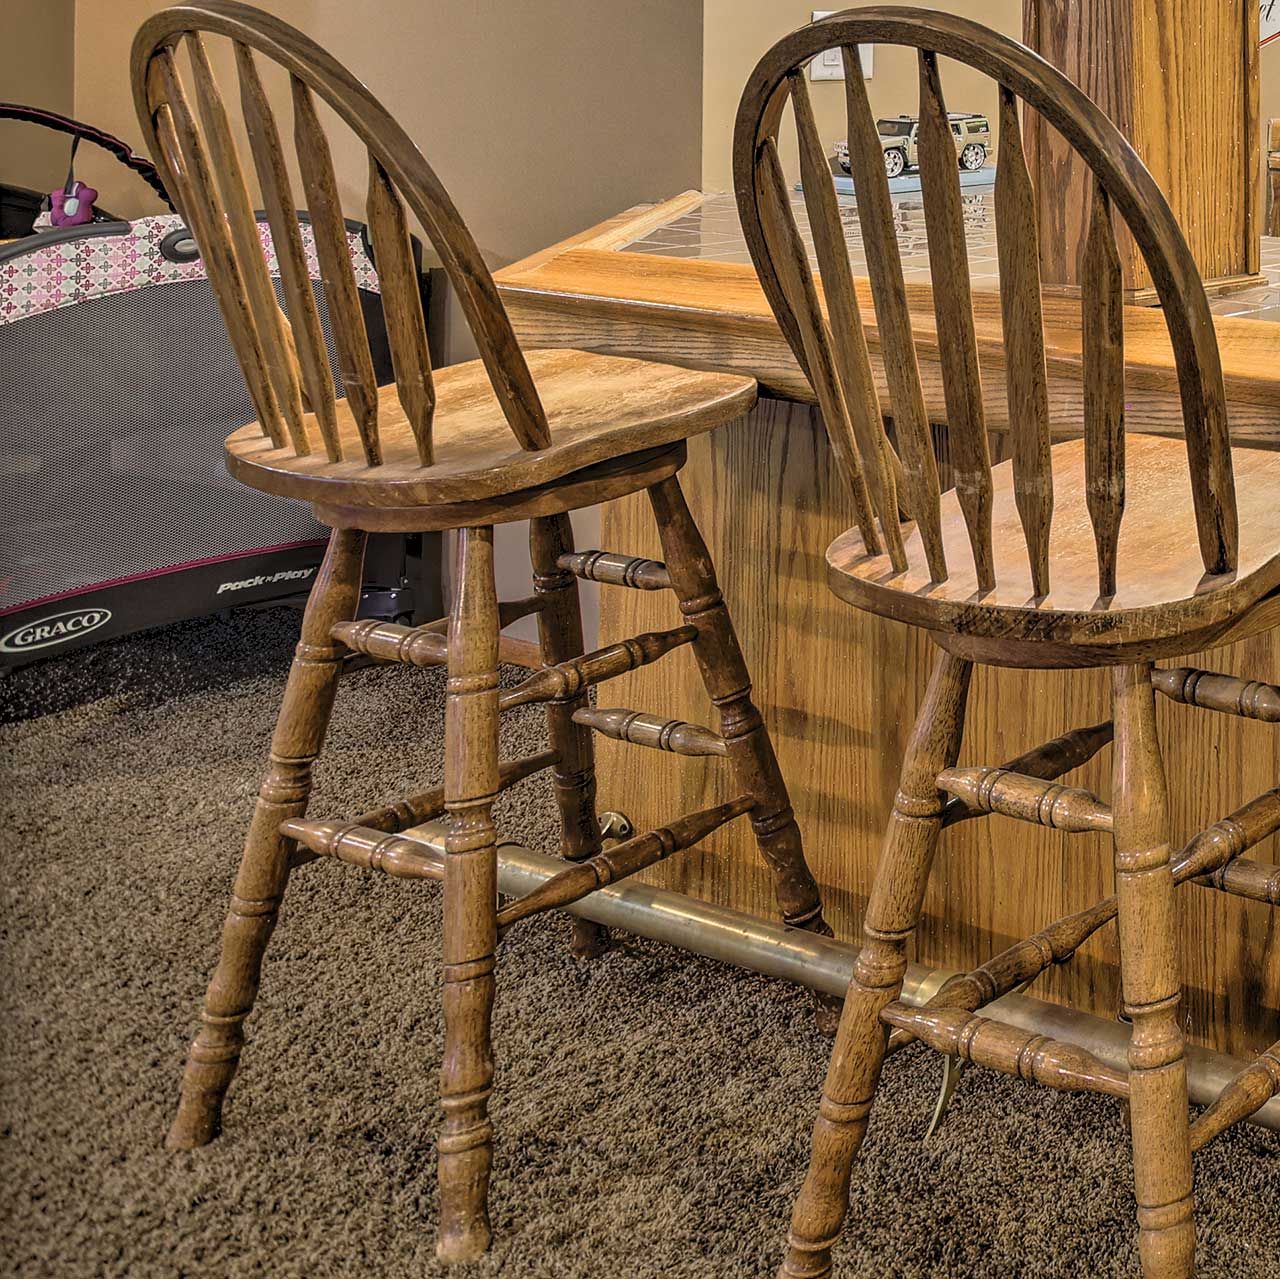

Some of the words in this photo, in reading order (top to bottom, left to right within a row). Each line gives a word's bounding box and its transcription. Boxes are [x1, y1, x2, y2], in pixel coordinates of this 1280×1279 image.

[216, 575, 266, 594] Pack
[272, 567, 314, 583] Play
[14, 612, 101, 646] GRACO
